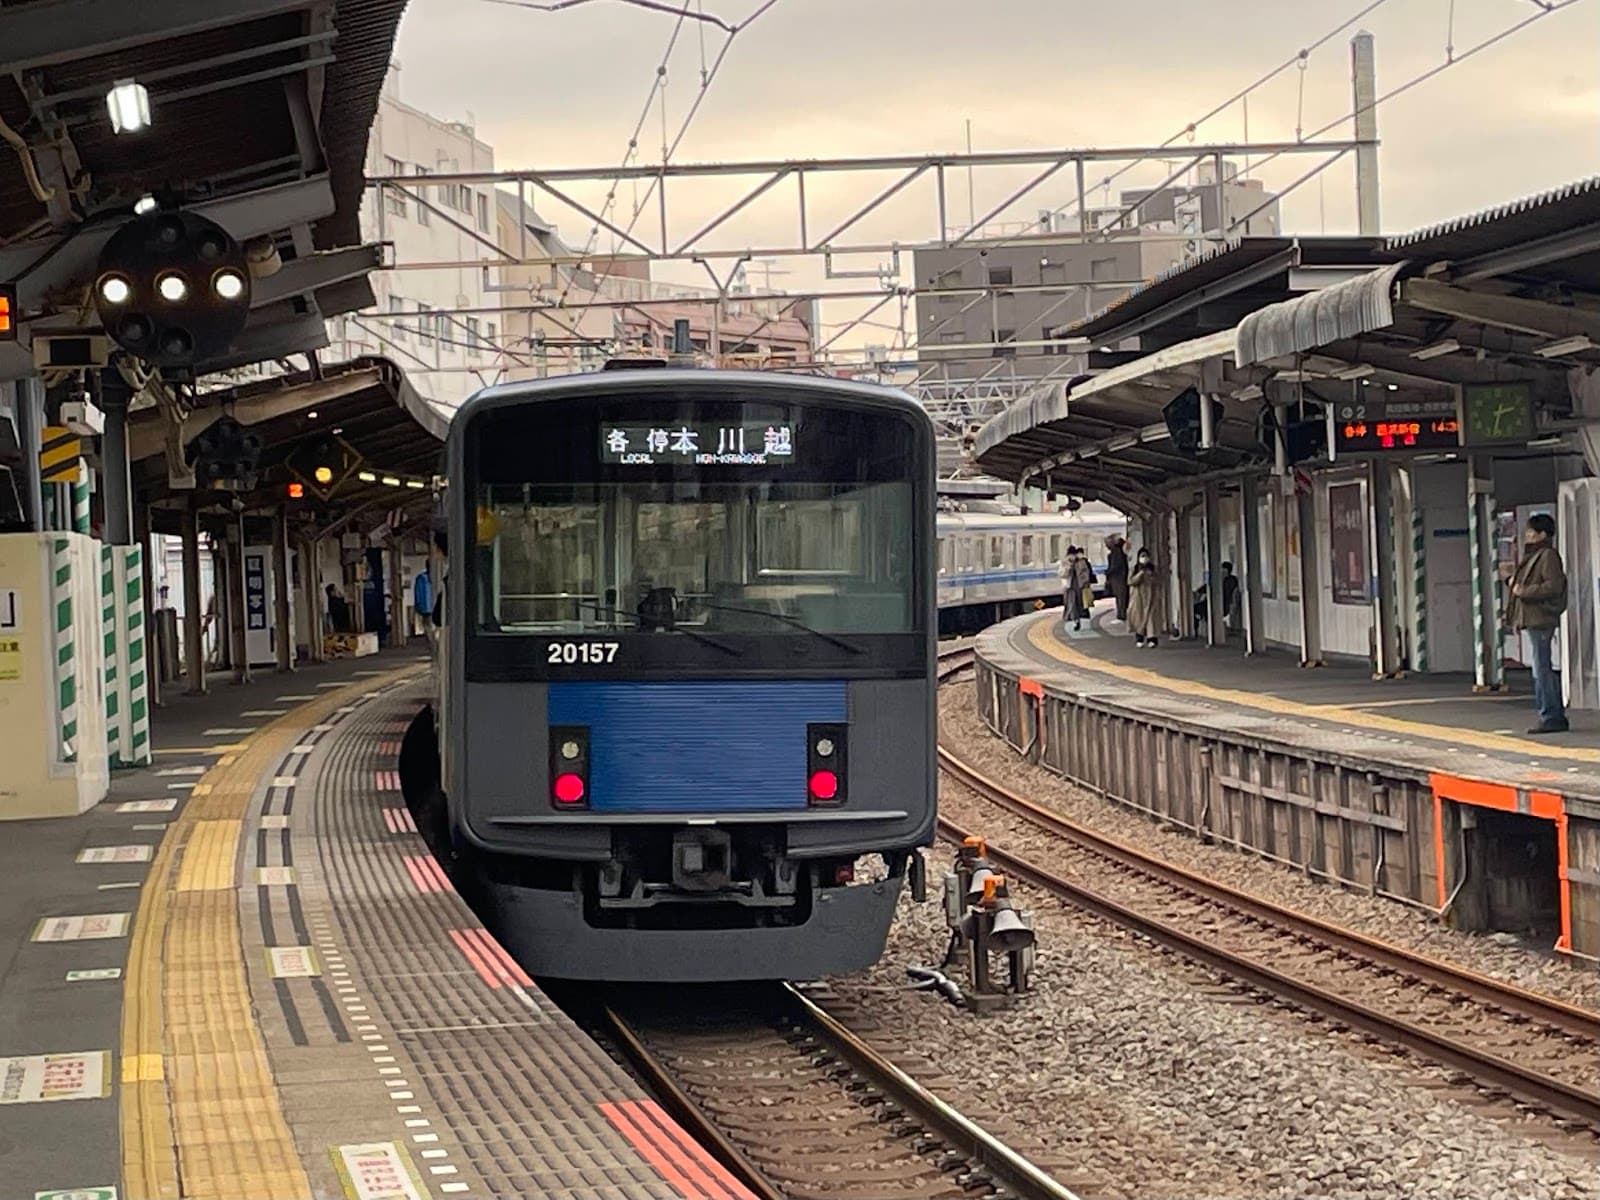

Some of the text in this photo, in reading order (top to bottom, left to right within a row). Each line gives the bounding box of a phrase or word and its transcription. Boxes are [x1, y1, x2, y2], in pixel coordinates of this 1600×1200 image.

[606, 427, 792, 455] 各停 本川越
[547, 643, 619, 663] 20157
